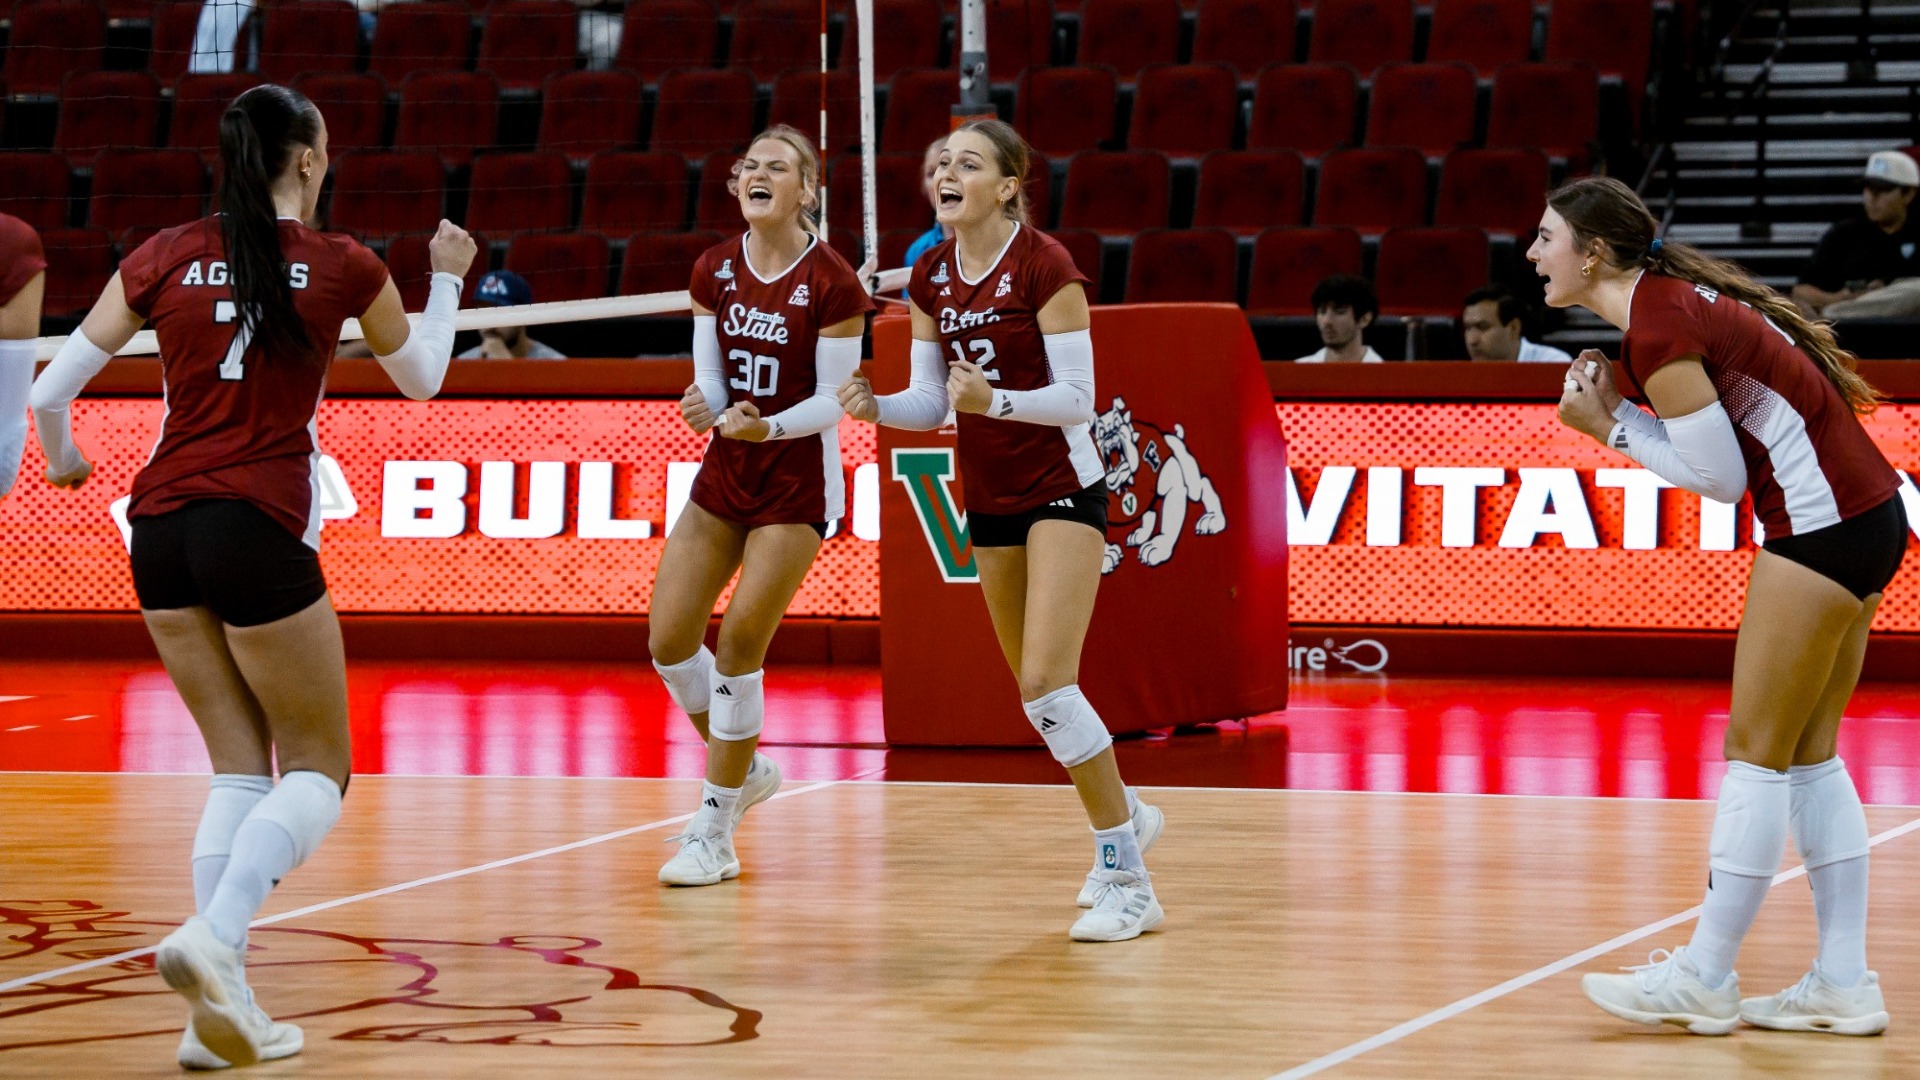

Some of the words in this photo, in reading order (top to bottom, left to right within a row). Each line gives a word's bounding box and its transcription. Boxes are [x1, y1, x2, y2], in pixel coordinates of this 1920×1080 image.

[182, 261, 309, 289] AGS
[788, 296, 809, 307] USA
[214, 299, 263, 381] 7
[723, 303, 788, 344] State
[728, 349, 780, 397] 30
[951, 338, 1001, 381] 12
[1123, 495, 1134, 513] V
